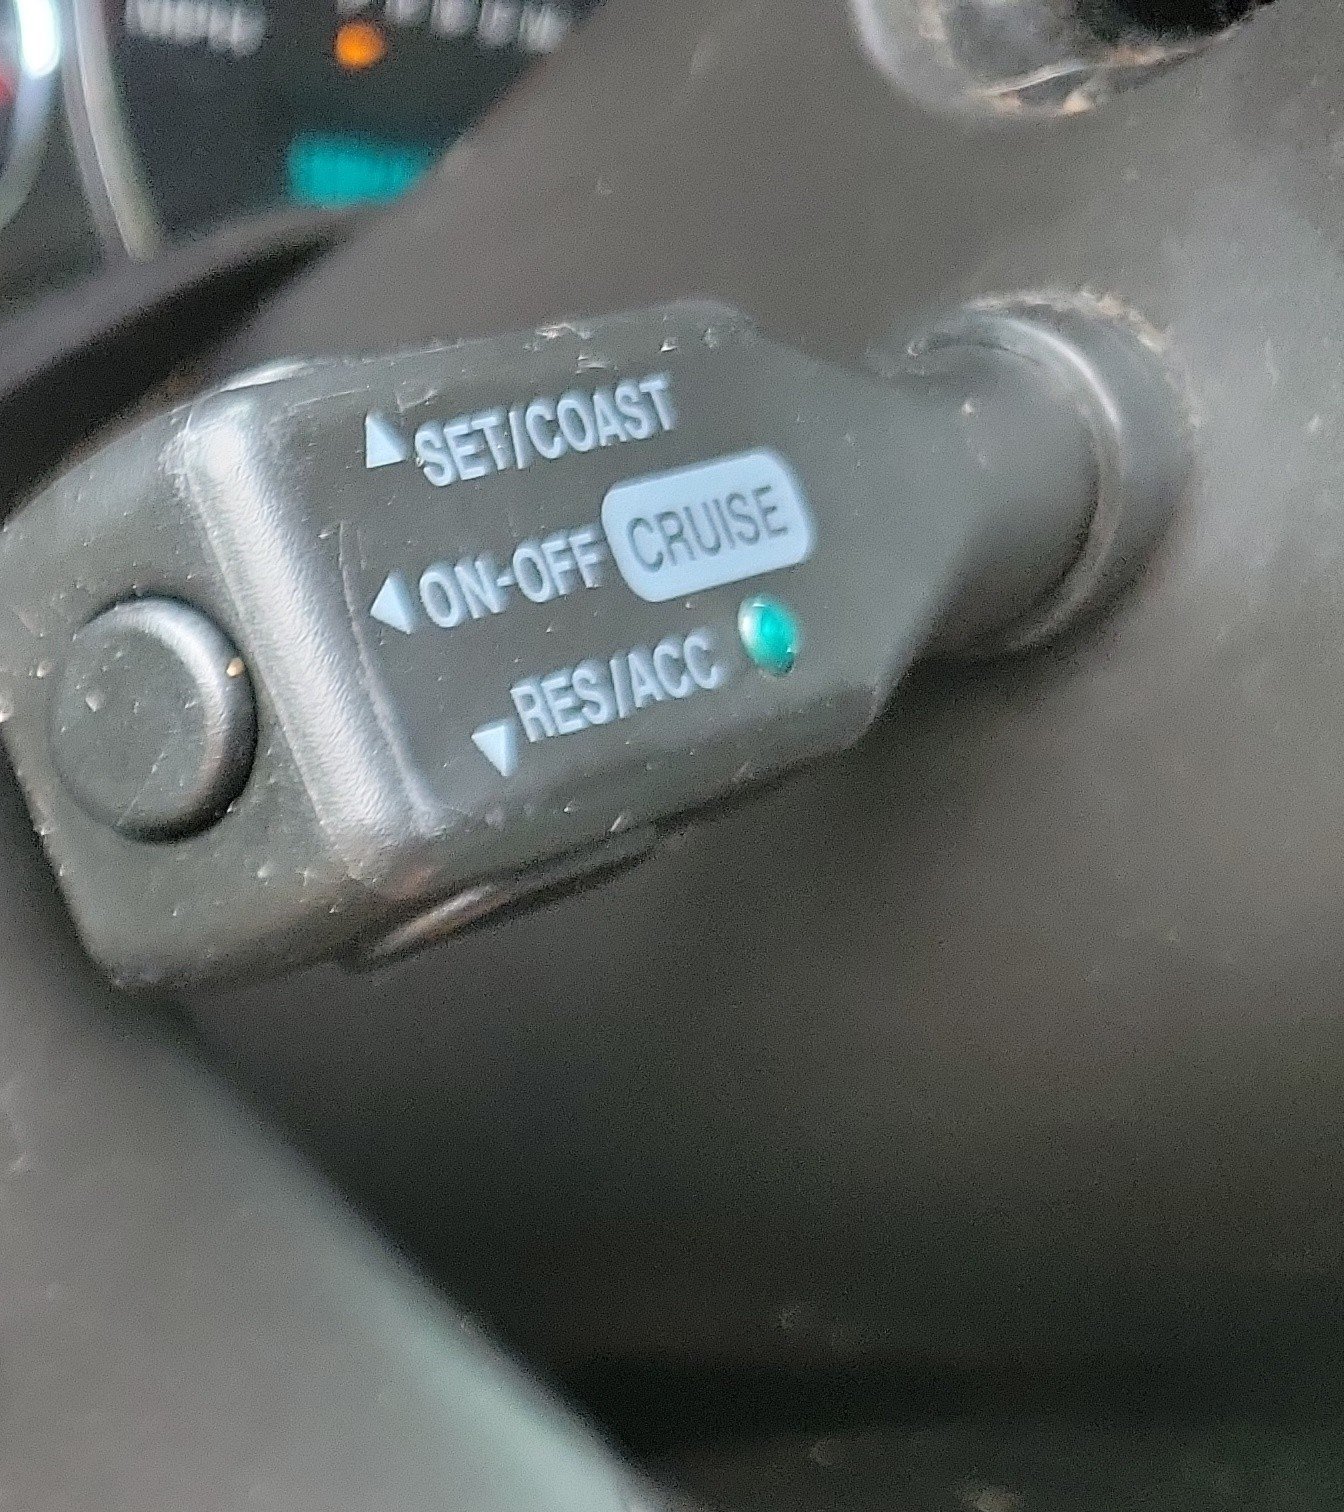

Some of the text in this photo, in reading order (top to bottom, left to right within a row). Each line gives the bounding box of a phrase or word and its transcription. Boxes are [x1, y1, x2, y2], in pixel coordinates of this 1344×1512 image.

[415, 375, 673, 487] SET/COAST
[419, 485, 788, 628] ON-OFF CRUISE
[511, 628, 721, 743] RES/ACC
